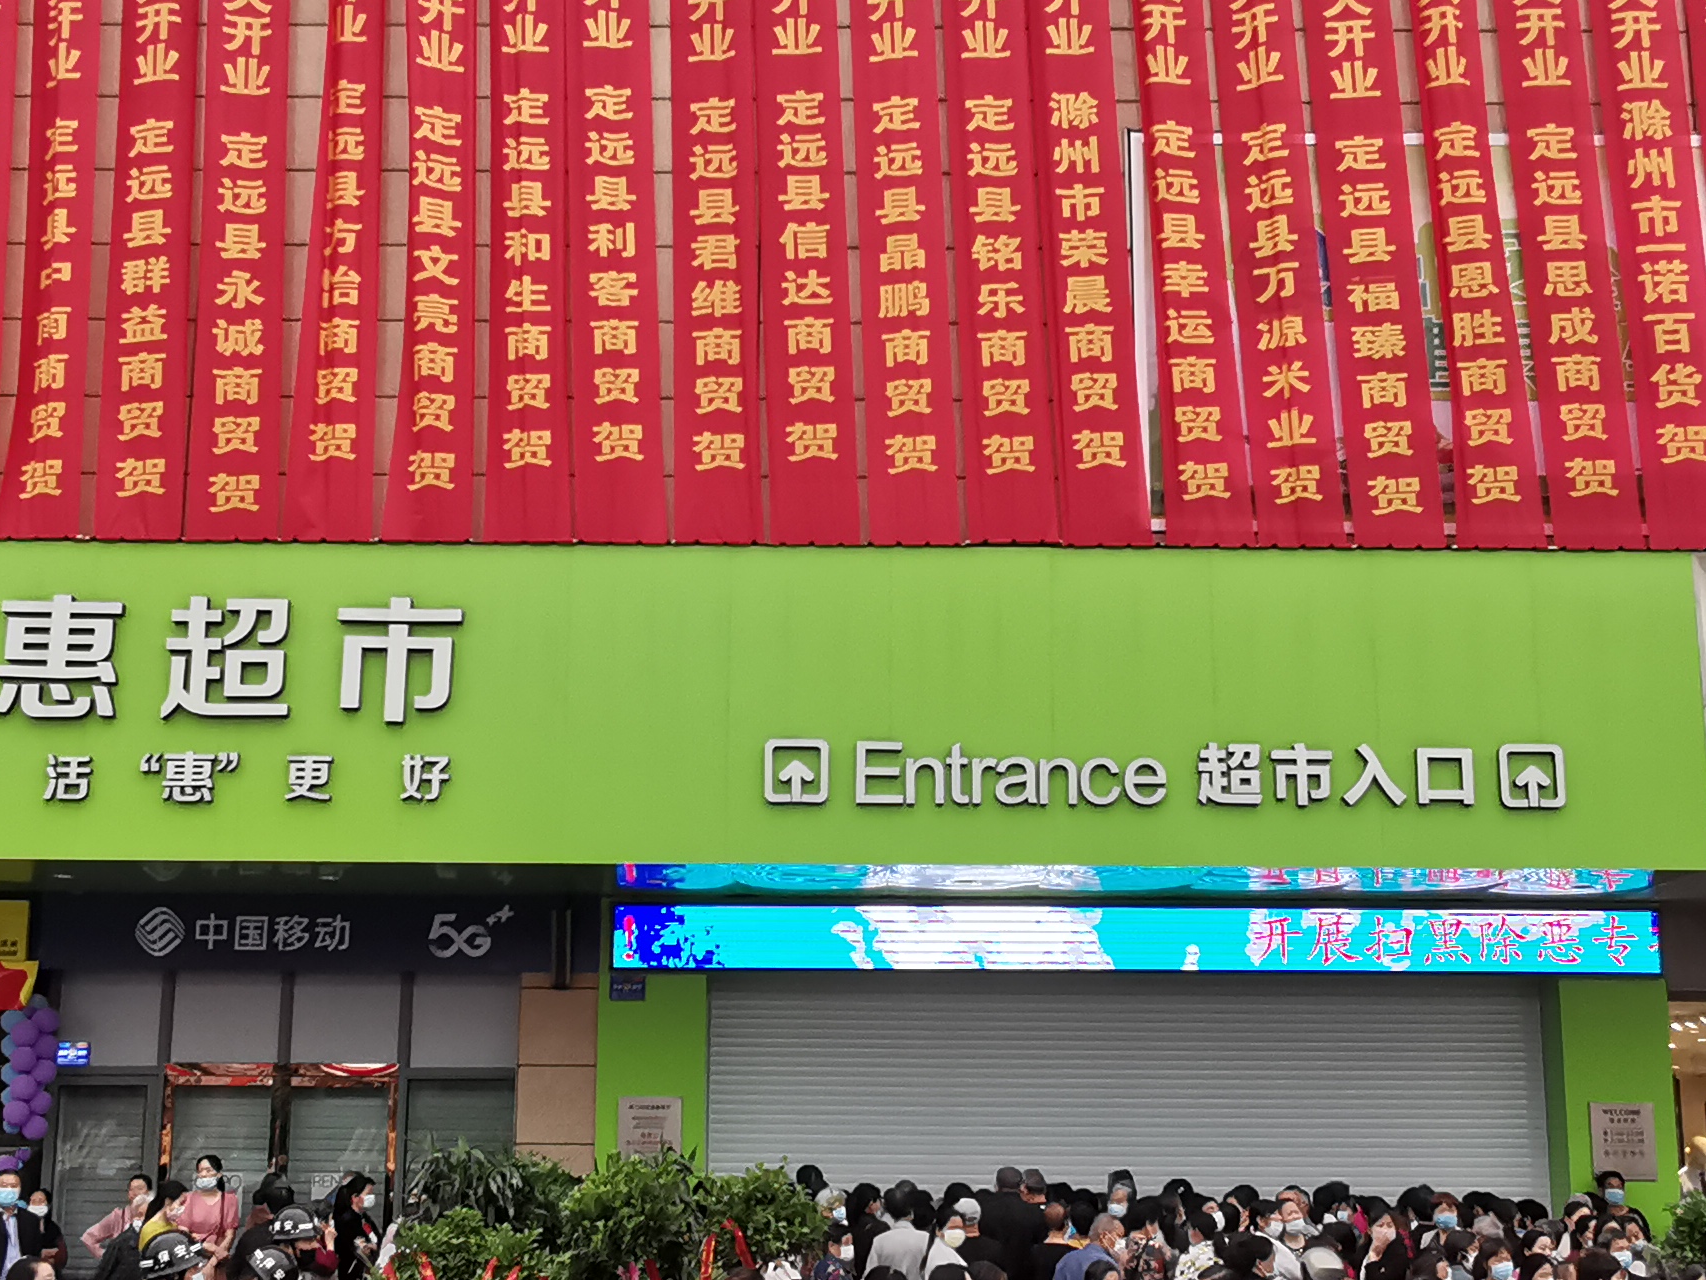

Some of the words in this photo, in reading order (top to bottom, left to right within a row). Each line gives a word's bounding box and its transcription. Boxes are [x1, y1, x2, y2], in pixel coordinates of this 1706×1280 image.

[117, 119, 174, 497] 定远县群益商贸贺
[210, 133, 268, 513] 定远县永诚商贸贺
[409, 106, 462, 491] 定远县文亮商贸贺
[505, 89, 551, 469] 定远县和生商贸贺
[586, 85, 643, 462] 定远县利客商贸贺
[691, 98, 744, 471] 定远县君维商贸贺
[778, 91, 838, 461] 定远县信达商贸贺
[966, 96, 1035, 474] 定远县铭乐商贸贺
[1051, 93, 1125, 469] 滁州市荣晨商贸贺
[1152, 121, 1230, 500] 定远县幸运商贸贺
[1242, 124, 1323, 504] 定远县万源米业贺
[1337, 136, 1422, 516] 定远县福臻商贸贺
[1422, 122, 1520, 505] 定远县恩胜商贸贺
[1527, 124, 1619, 497] 定远县思成商贸贺
[194, 913, 351, 952] 中国移动
[855, 740, 1167, 807] Entrance
[1197, 742, 1477, 808] 超市入口
[1255, 912, 1661, 970] 开展扫黑除恶专
